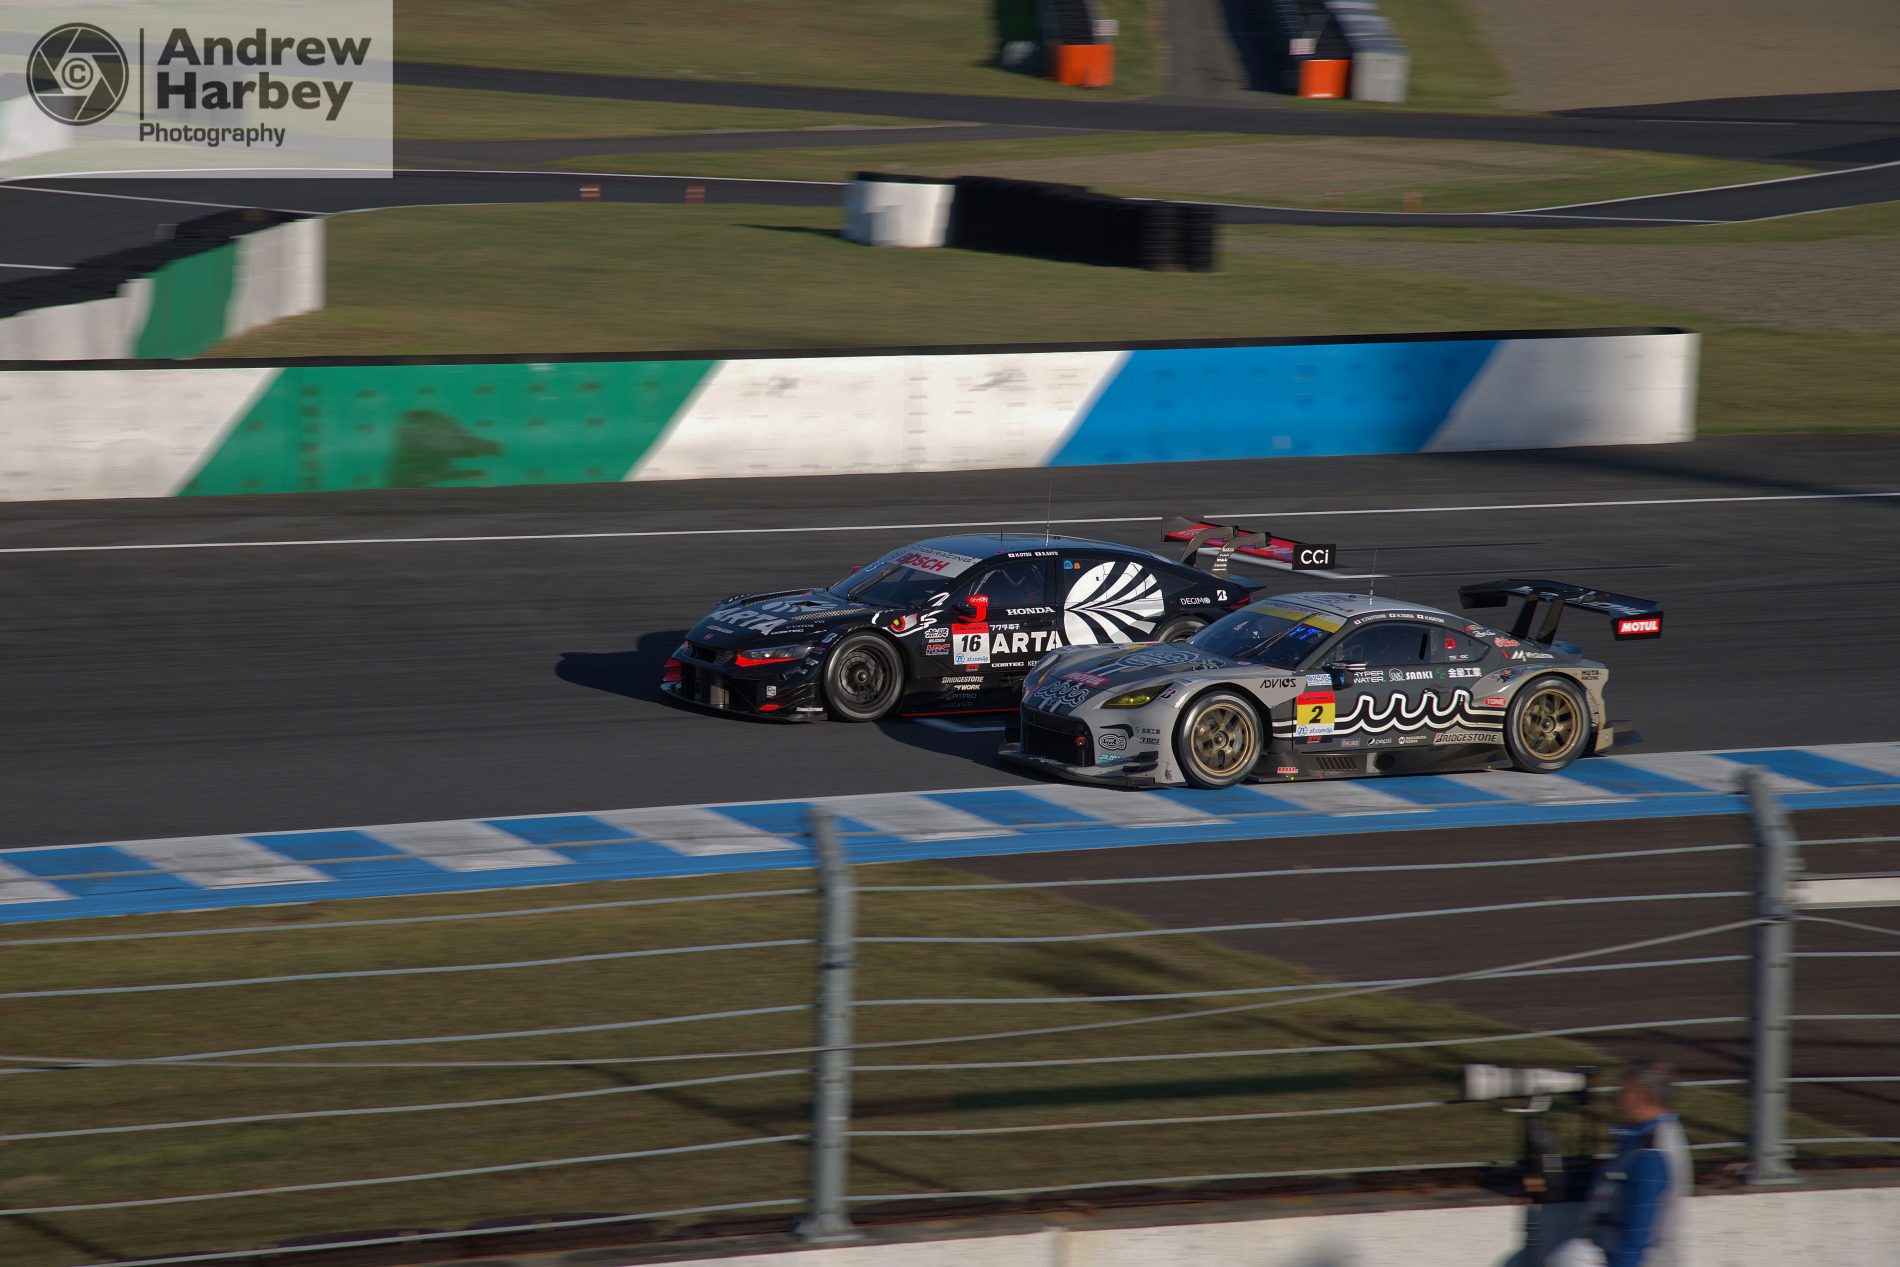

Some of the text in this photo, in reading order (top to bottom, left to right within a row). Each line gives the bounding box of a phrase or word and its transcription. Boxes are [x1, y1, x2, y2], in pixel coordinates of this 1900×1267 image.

[1005, 606, 1056, 616] HONDA
[707, 607, 788, 636] ARTA
[1620, 621, 1658, 632] MOTUL
[961, 635, 982, 653] 16
[991, 630, 1064, 654] ARTA
[941, 676, 985, 684] BRIDGESTONE
[1406, 671, 1434, 680] SANKI
[1259, 678, 1297, 689] ADVICS
[1309, 705, 1323, 724] 2
[1376, 737, 1392, 745] pepsi
[1435, 733, 1498, 743] BRIDGESTONE
